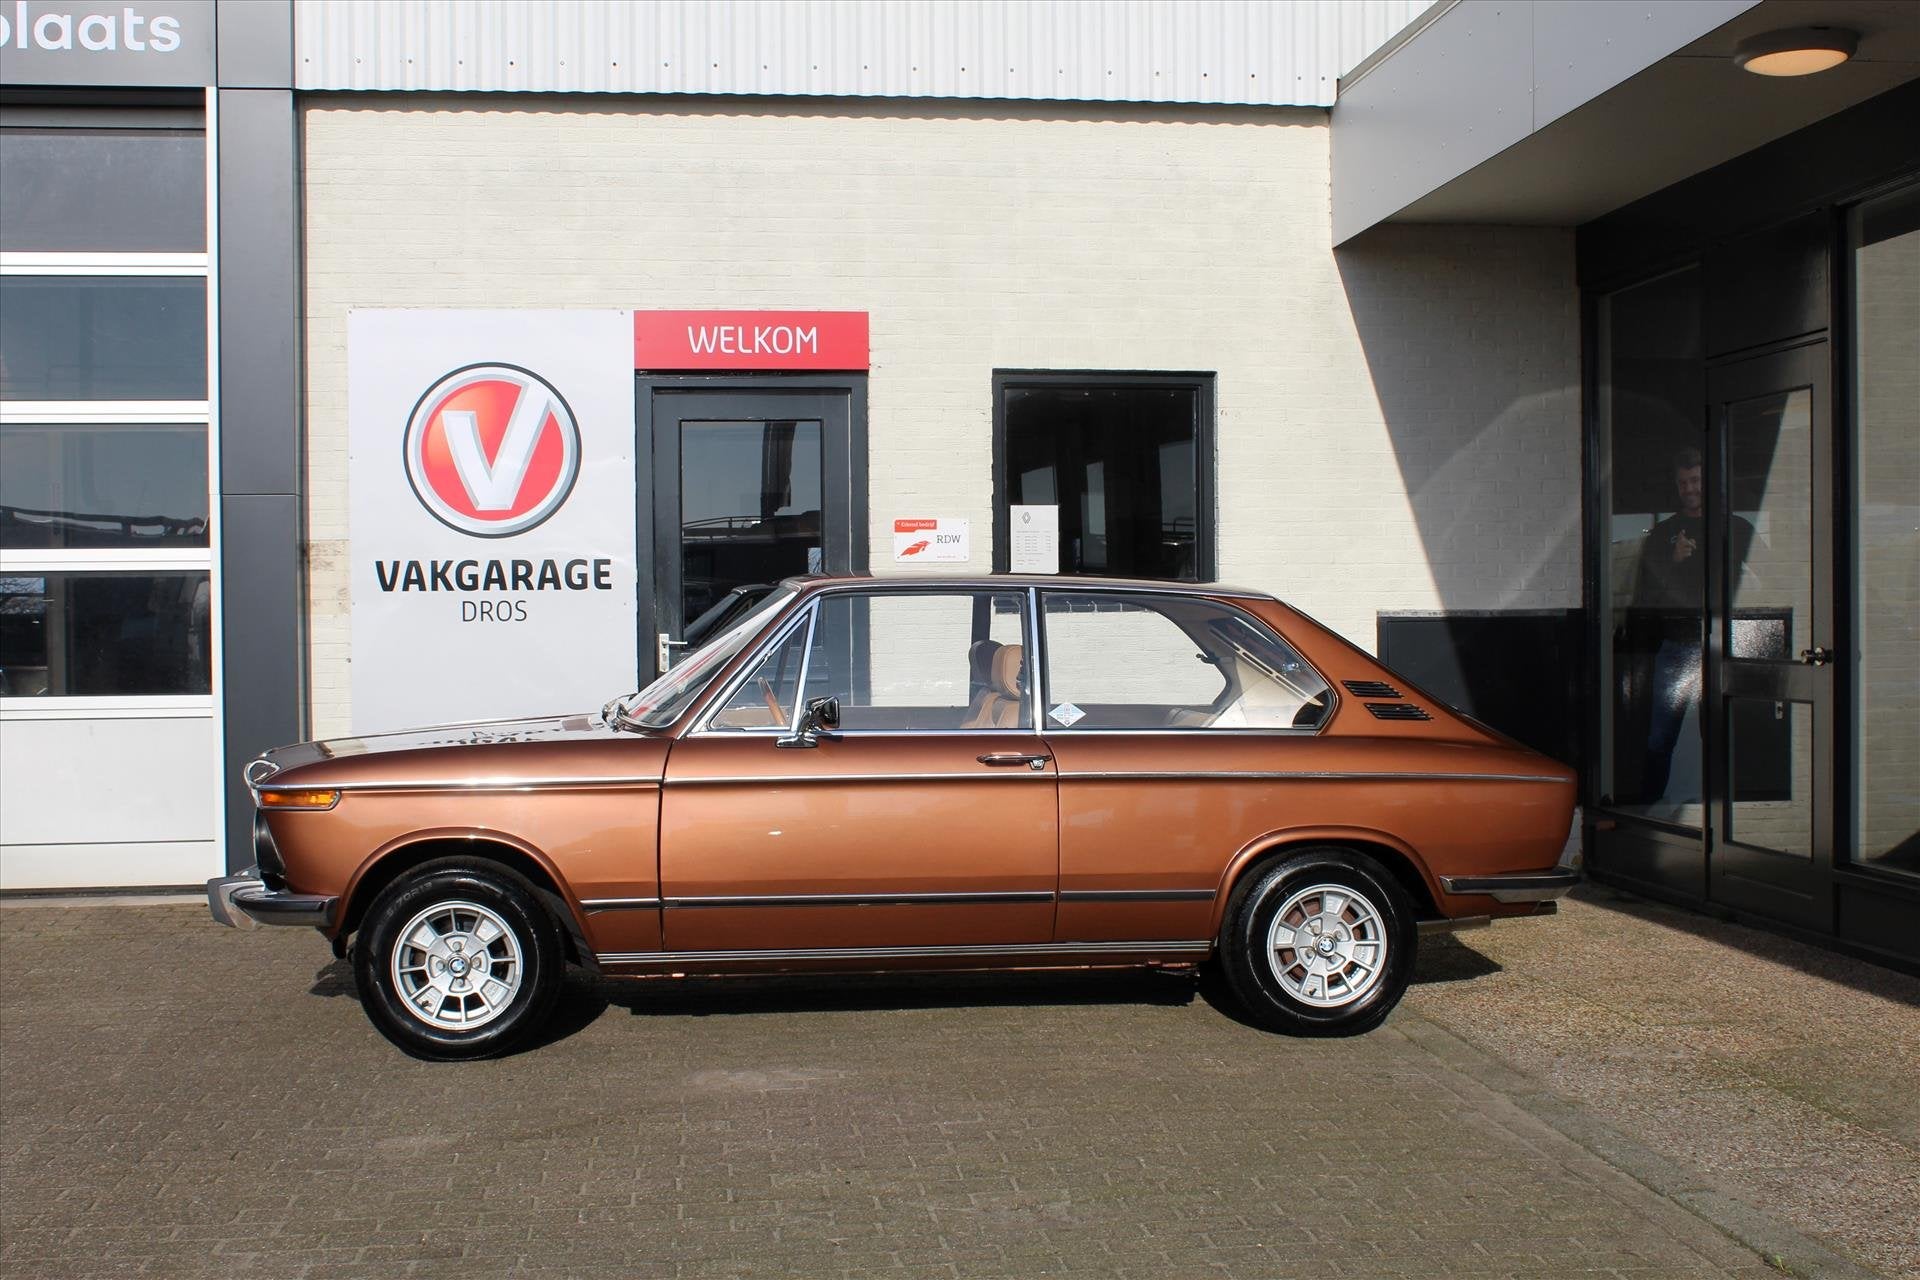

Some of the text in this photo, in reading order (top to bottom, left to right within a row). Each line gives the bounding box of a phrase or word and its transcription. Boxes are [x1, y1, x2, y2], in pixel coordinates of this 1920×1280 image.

[0, 0, 182, 52] laats
[687, 326, 818, 354] WELKOM
[936, 534, 961, 544] RDW
[375, 559, 613, 592] VAKGARAGE
[461, 600, 528, 623] DROS
